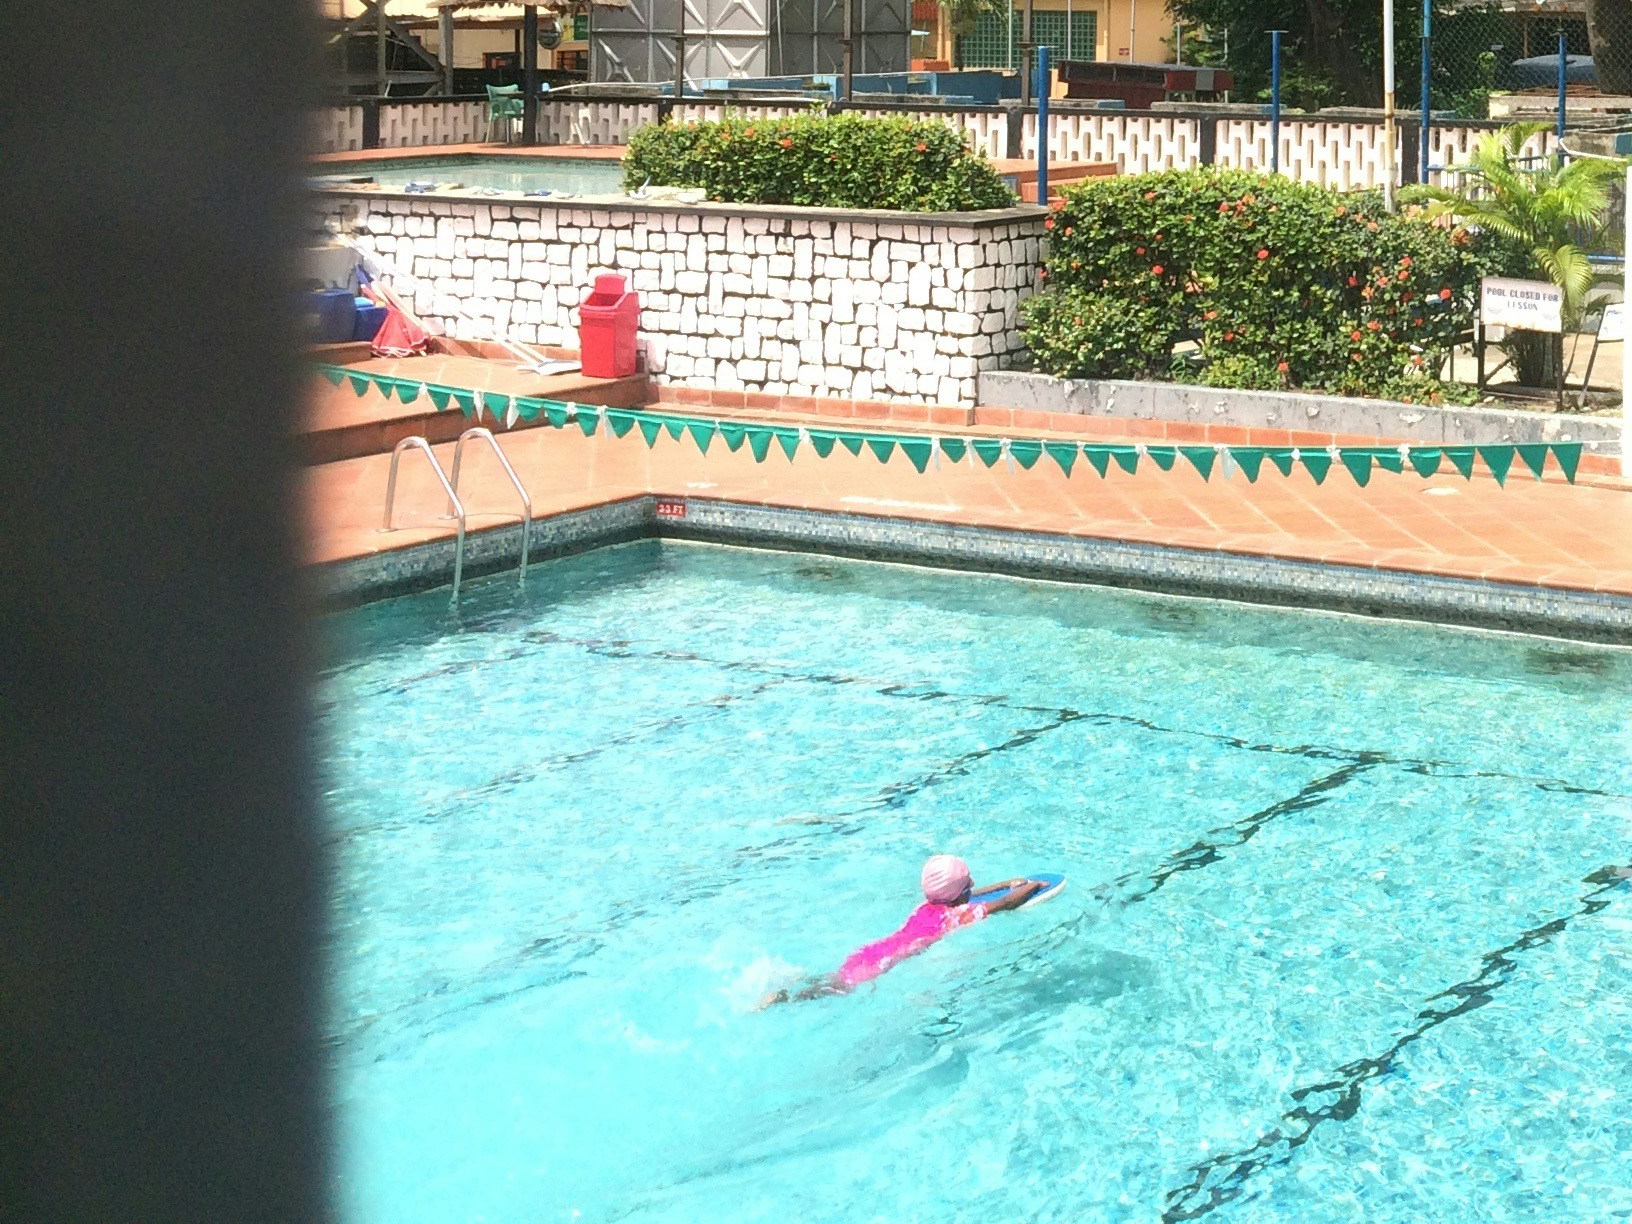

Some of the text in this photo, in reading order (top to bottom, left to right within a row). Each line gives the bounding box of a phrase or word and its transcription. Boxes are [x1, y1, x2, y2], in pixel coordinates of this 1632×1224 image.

[1486, 287, 1559, 302] POOL CLOSED FOR
[1507, 300, 1538, 311] LESSON
